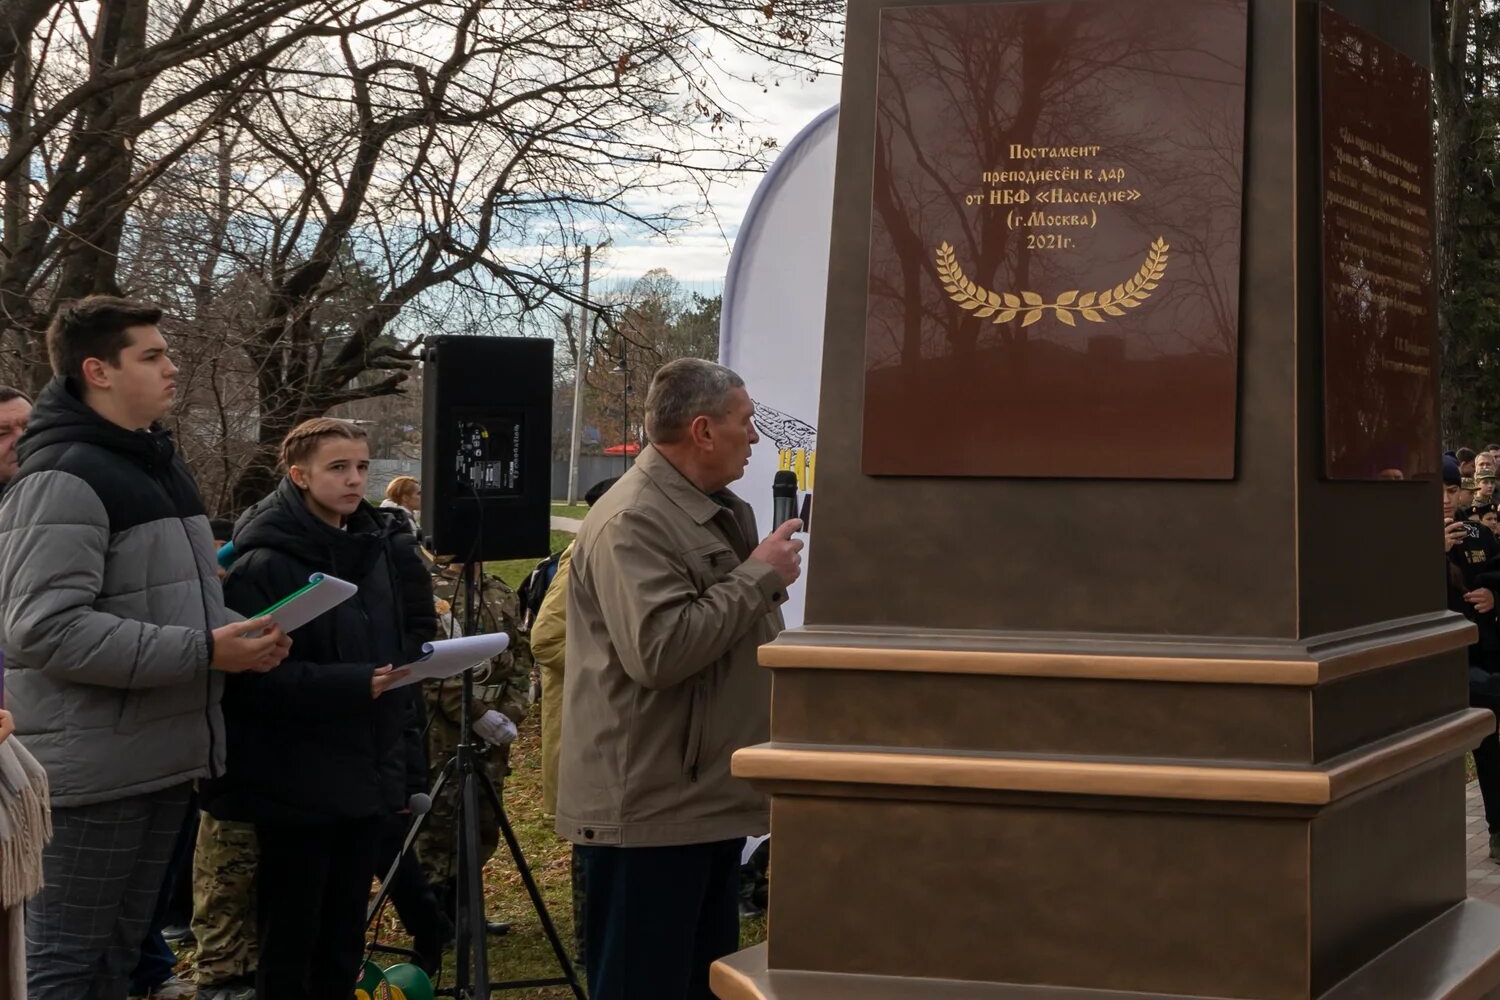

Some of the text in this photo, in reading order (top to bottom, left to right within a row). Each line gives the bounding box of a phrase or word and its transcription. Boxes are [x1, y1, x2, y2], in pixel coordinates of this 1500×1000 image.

[1009, 144, 1100, 159] Постамент
[983, 167, 1125, 185] преподнесён в дар
[965, 189, 1141, 206] от НБФ «Наследие»
[1006, 209, 1097, 230] (г.Москва)
[1026, 234, 1076, 249] 2021г.
